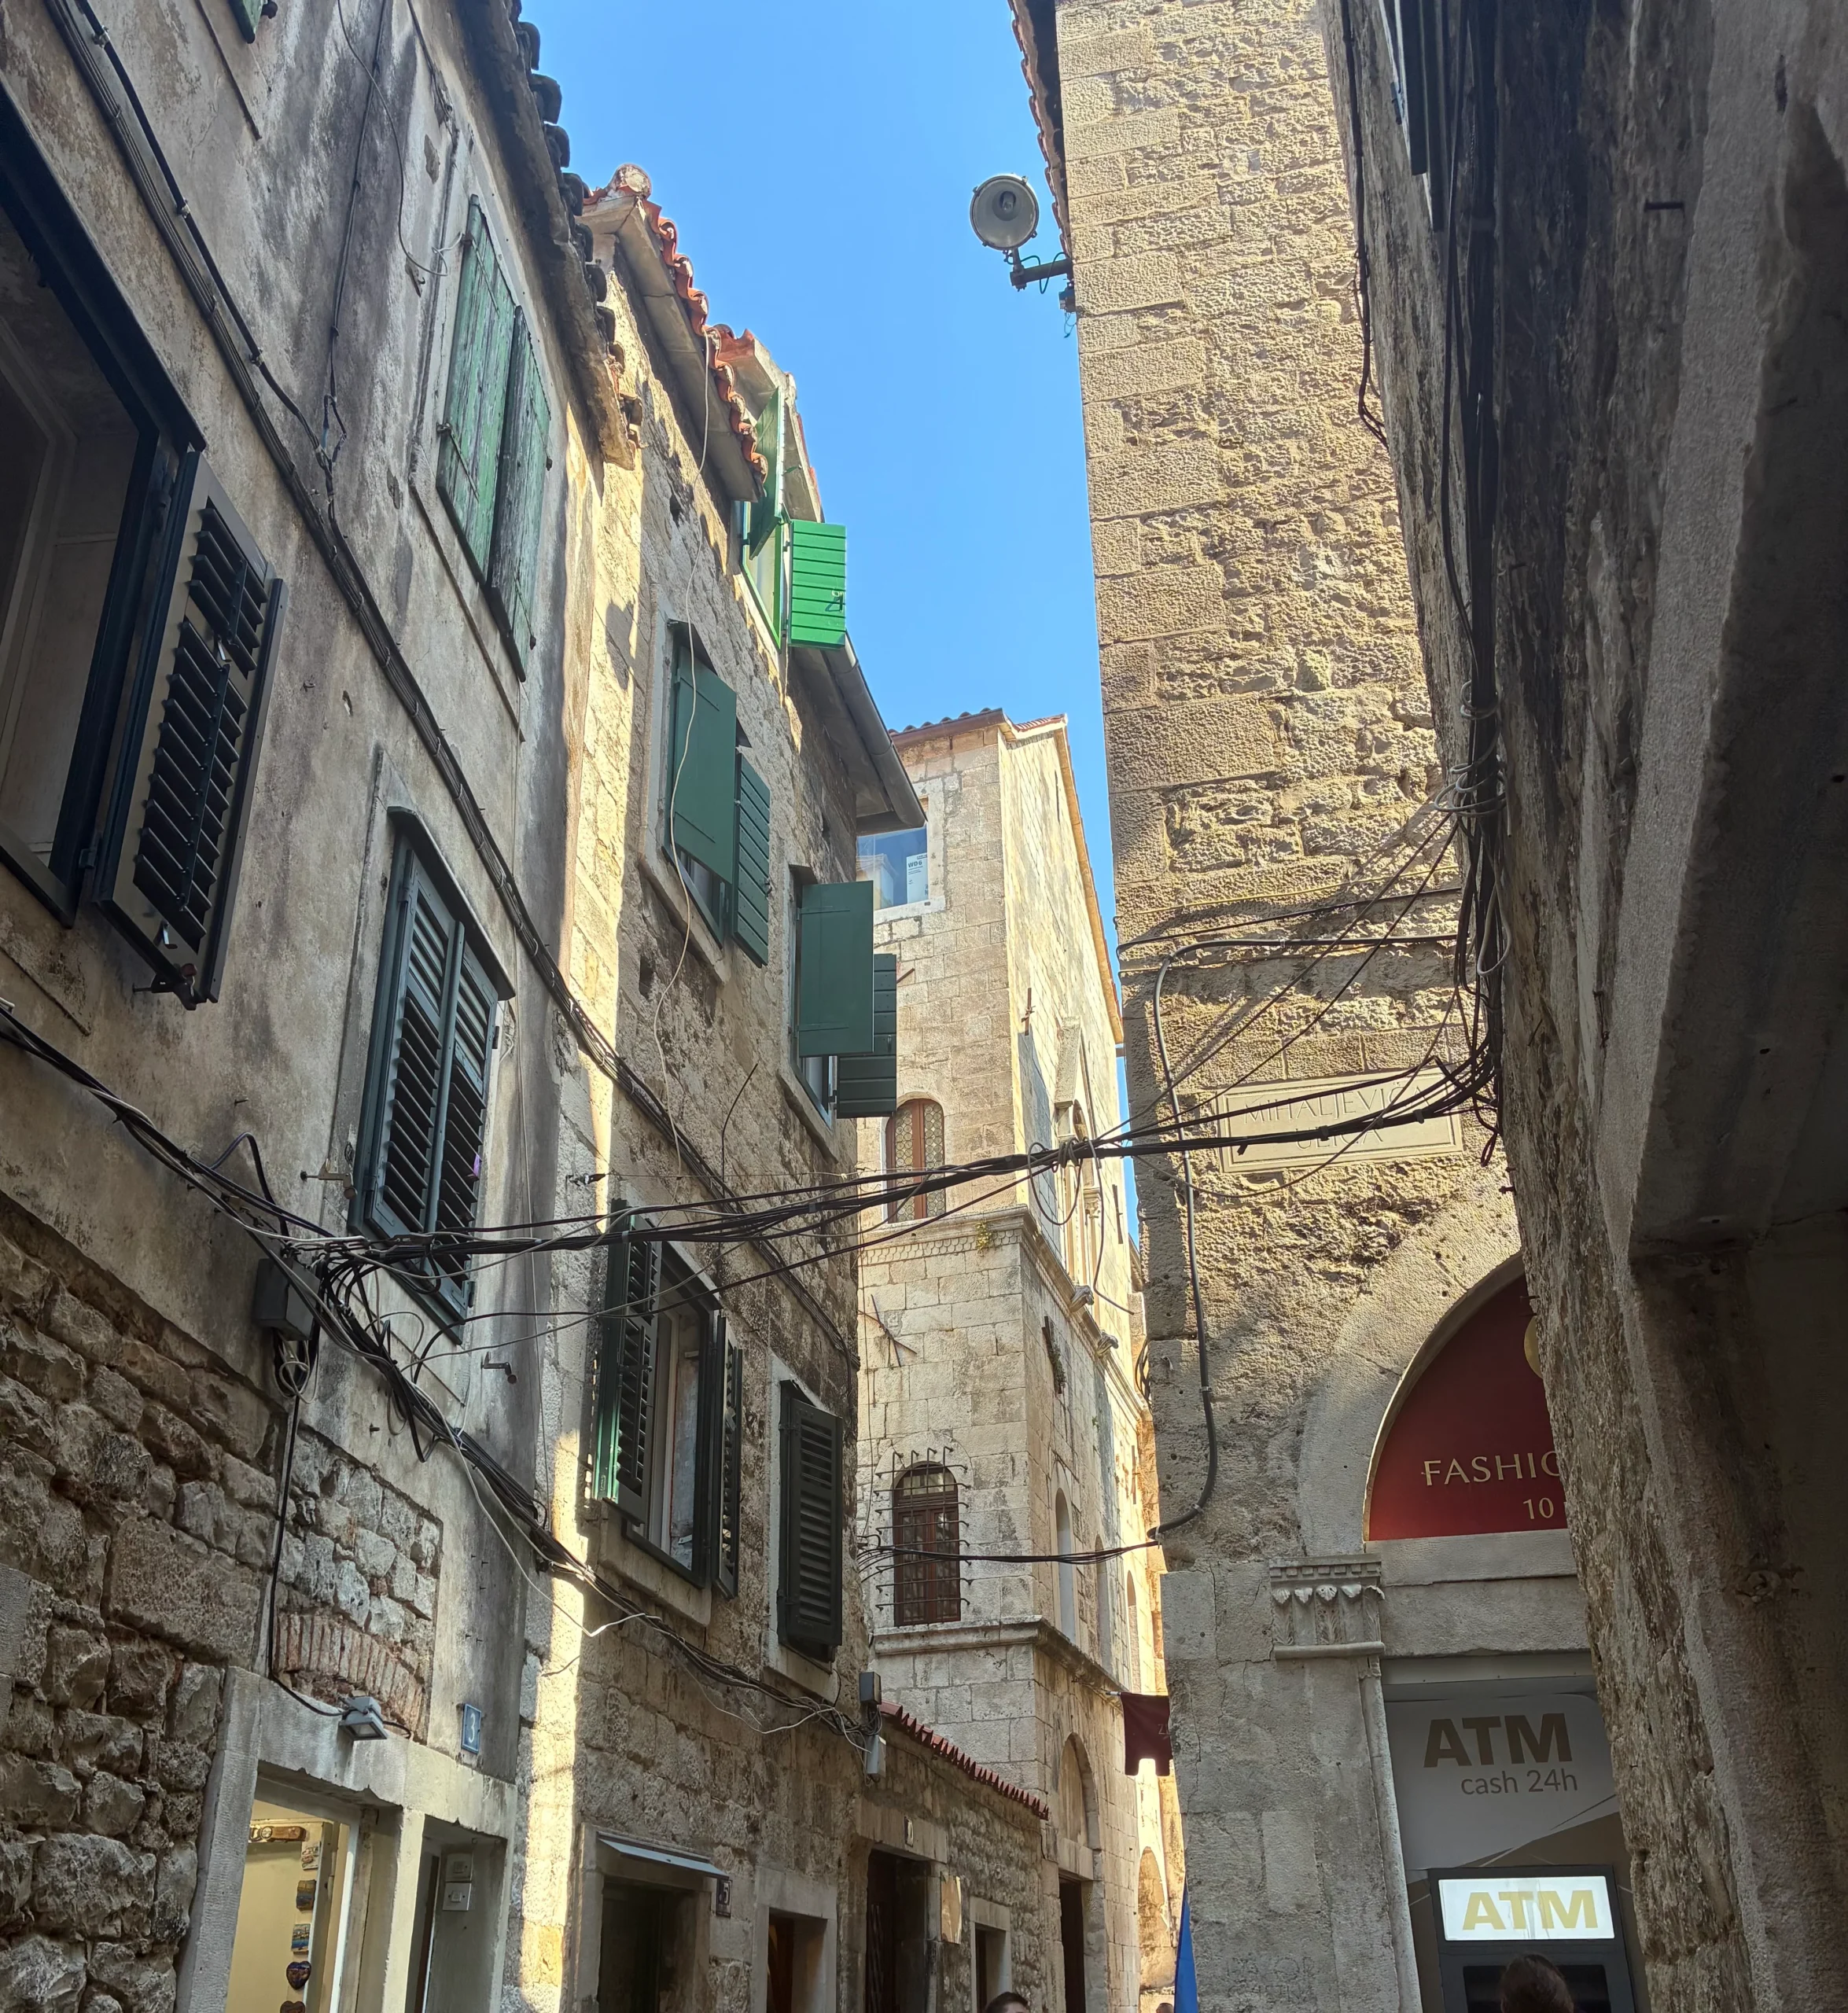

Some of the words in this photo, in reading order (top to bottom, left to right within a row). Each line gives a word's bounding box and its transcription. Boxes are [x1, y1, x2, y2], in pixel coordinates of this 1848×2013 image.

[1523, 1497, 1554, 1519] 10
[468, 1713, 476, 1743] 3
[1423, 1713, 1573, 1768] ATM
[1461, 1770, 1519, 1795] cash
[1526, 1768, 1577, 1792] 24h
[1463, 1890, 1598, 1930] ATM
